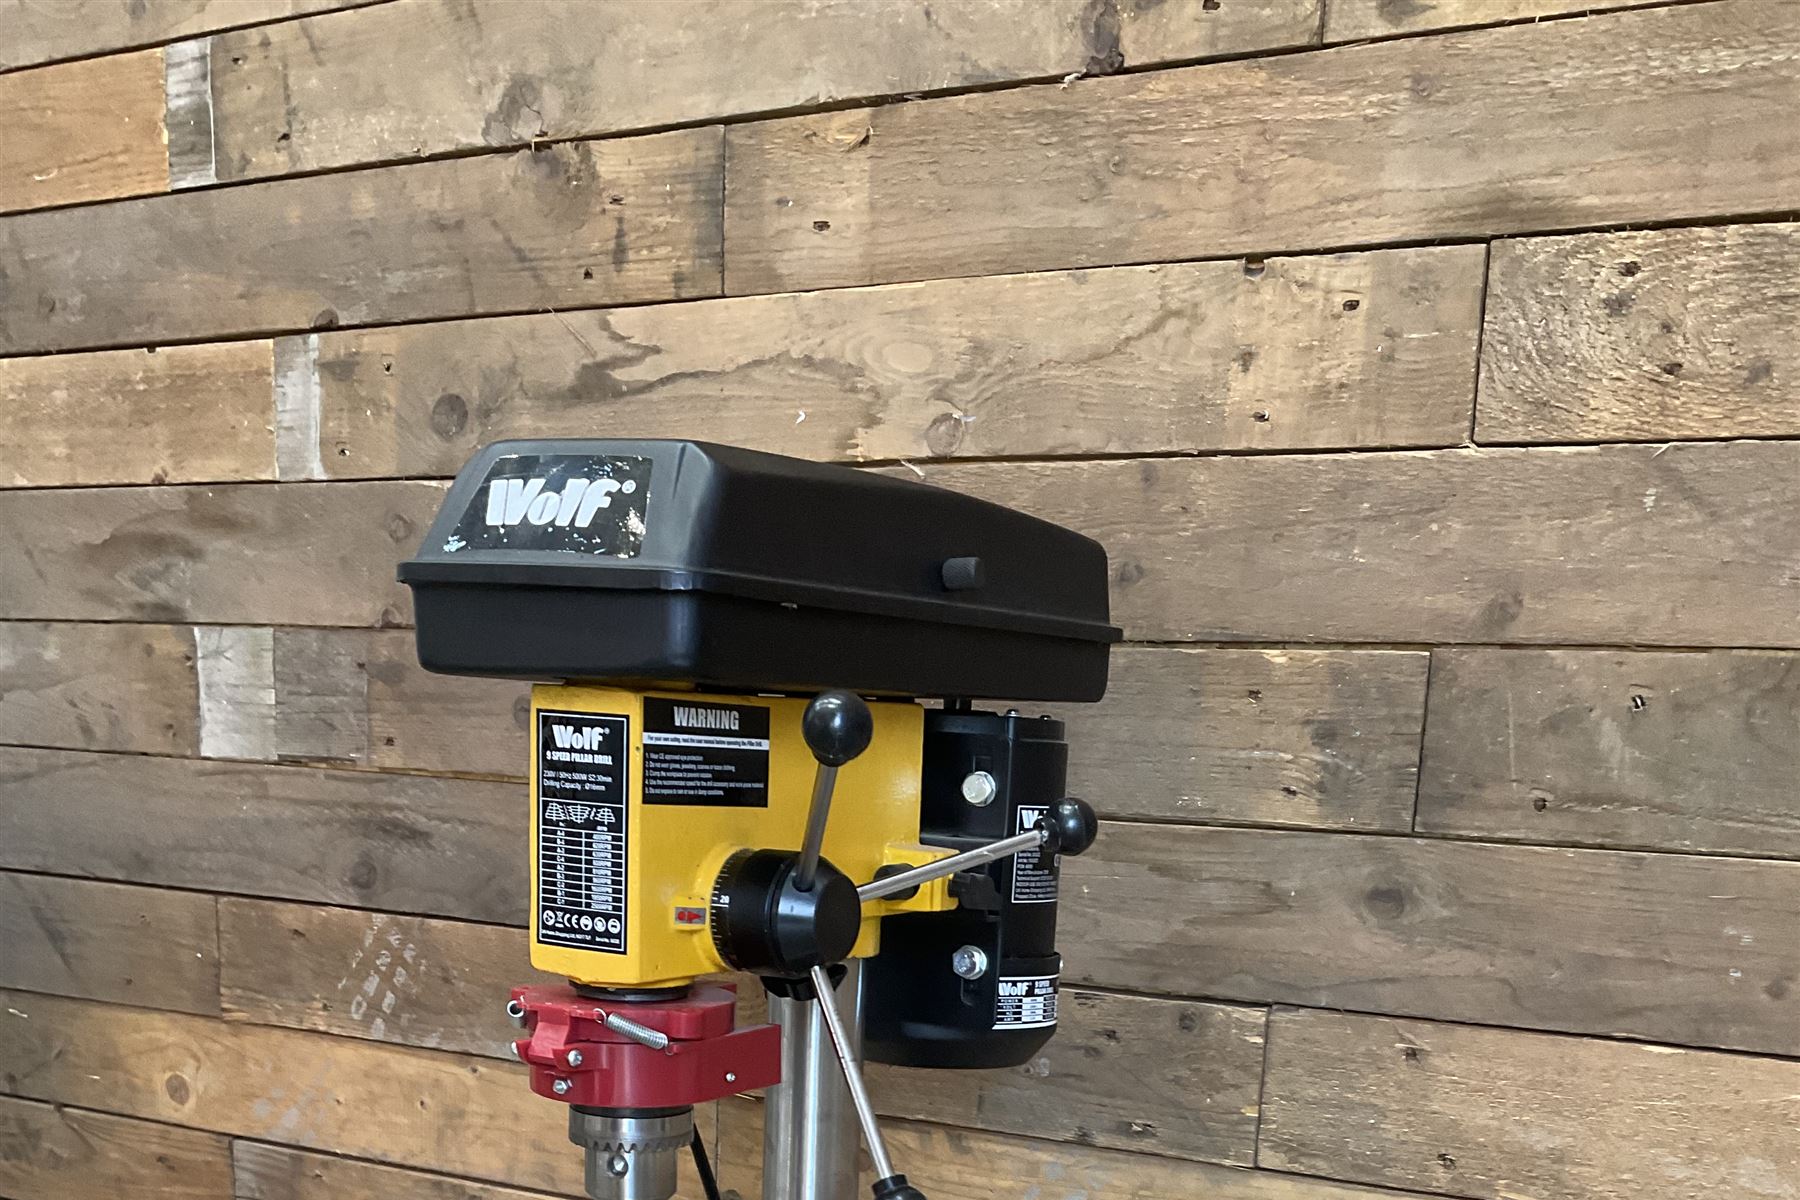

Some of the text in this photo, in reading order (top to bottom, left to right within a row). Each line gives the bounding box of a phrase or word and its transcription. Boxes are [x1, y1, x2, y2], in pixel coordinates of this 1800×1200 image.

[673, 706, 740, 730] WARNING
[546, 751, 551, 760] 9
[571, 752, 593, 763] PILLAR
[594, 754, 612, 765] DRILL
[720, 895, 730, 904] 20
